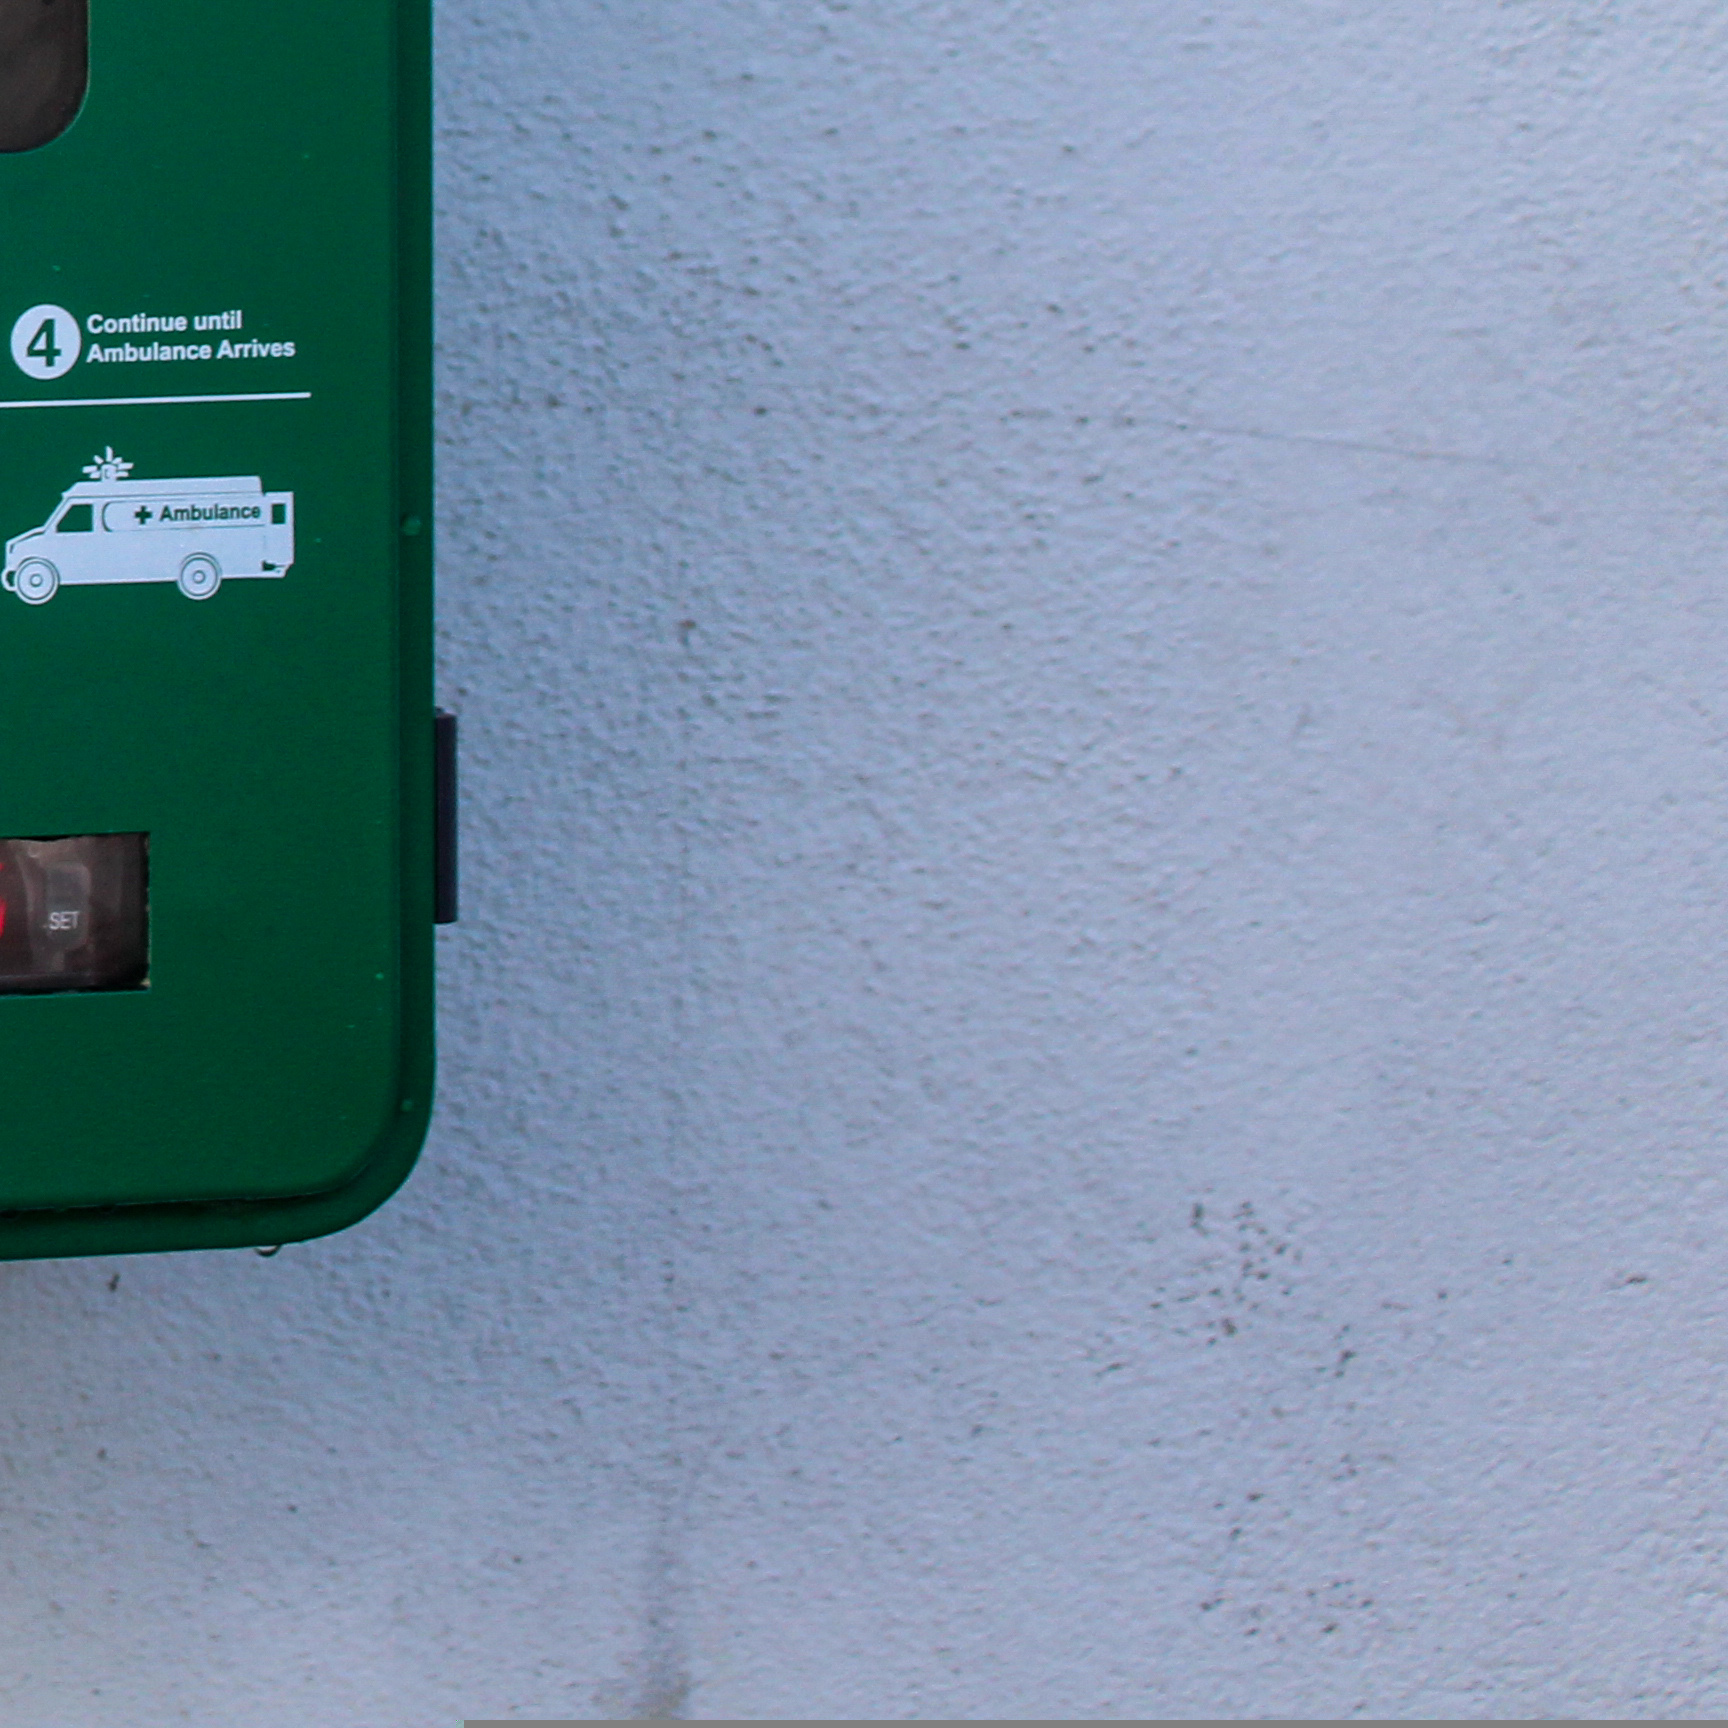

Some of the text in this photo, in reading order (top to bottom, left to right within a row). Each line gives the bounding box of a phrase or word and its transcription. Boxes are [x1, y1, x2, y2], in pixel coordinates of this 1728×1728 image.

[88, 310, 241, 333] Continue until
[27, 319, 62, 367] 4
[87, 339, 295, 362] Ambulance Arrives
[159, 504, 262, 522] Ambulance
[48, 910, 81, 931] SET
